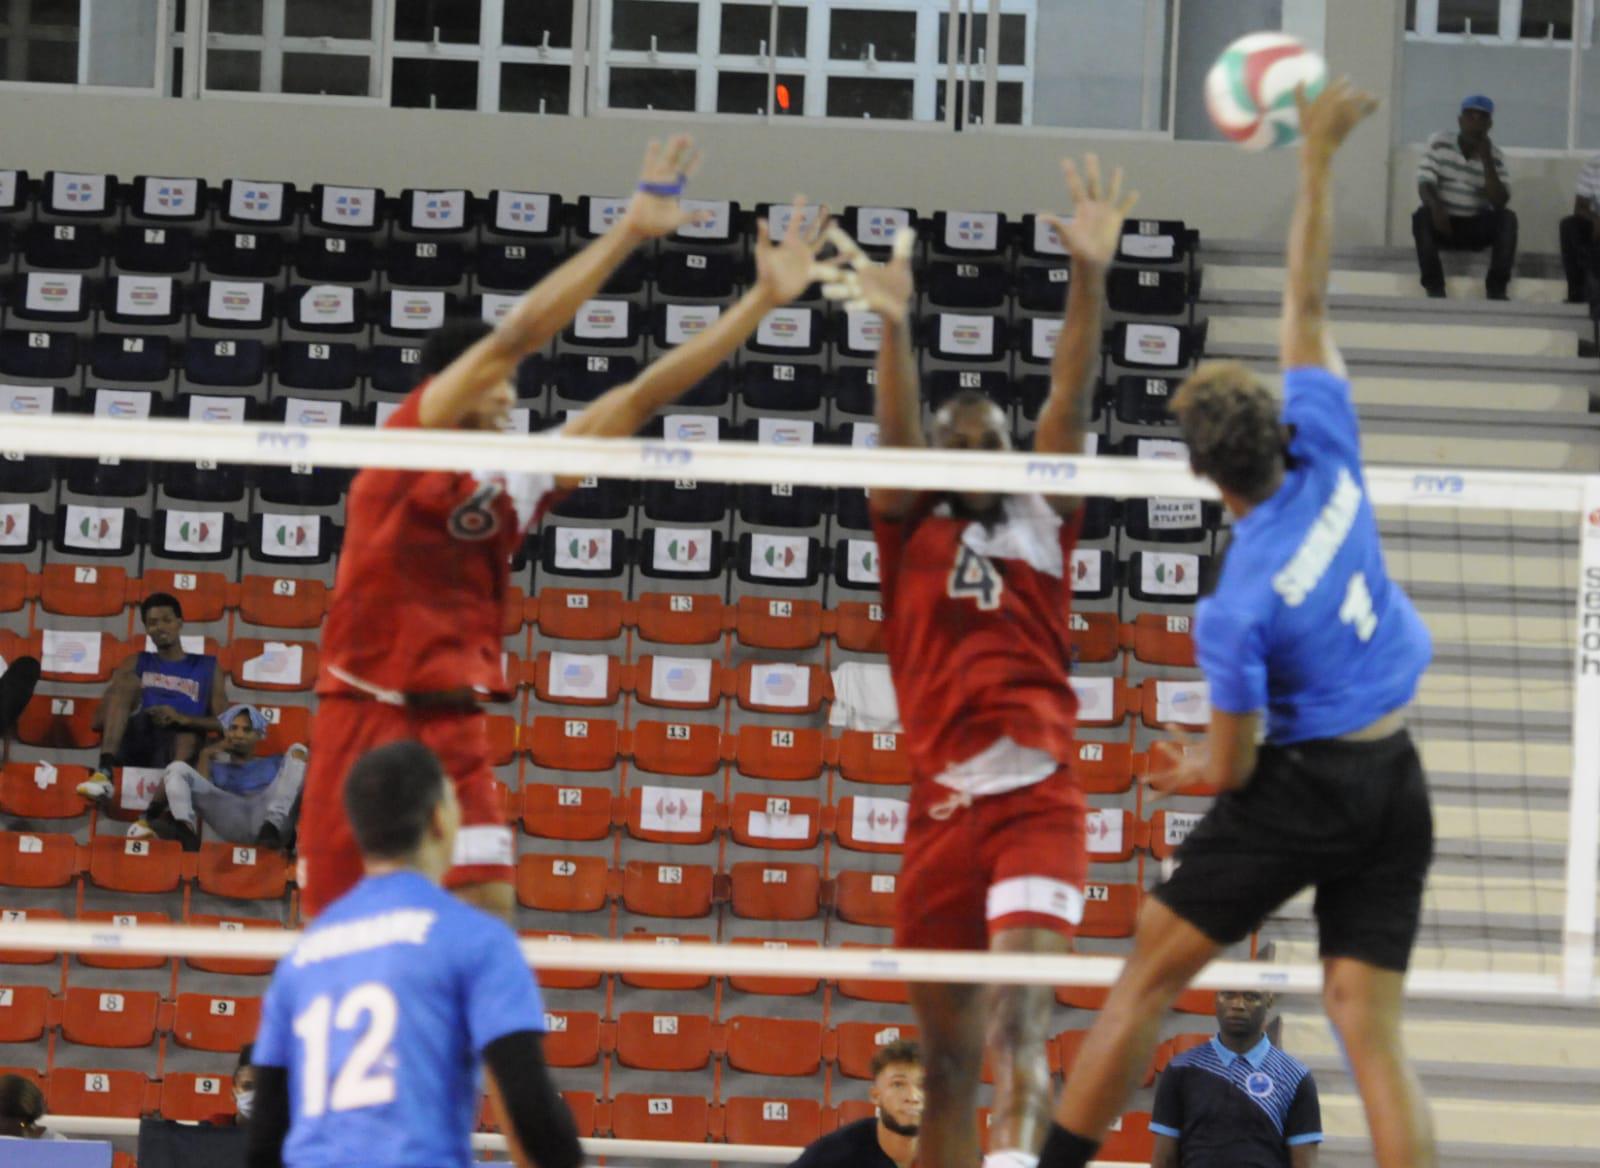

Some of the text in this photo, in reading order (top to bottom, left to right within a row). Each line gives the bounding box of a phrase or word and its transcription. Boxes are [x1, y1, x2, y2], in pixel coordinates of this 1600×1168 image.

[60, 226, 69, 238] 6
[152, 229, 160, 242] 7
[241, 235, 249, 247] 8
[331, 240, 340, 252] 9
[419, 244, 435, 256] 10
[35, 333, 44, 346] 6
[129, 338, 137, 352] 7
[220, 342, 228, 355] 8
[315, 345, 323, 358] 9
[403, 349, 419, 362] 10
[590, 357, 606, 370] 12
[776, 366, 792, 379] 14
[962, 373, 979, 386] 16
[447, 481, 502, 541] 6
[81, 569, 90, 582] 7
[181, 575, 190, 588] 8
[947, 544, 1003, 611] 4
[280, 580, 290, 593] 9
[571, 597, 584, 606] 12
[673, 597, 690, 610] 13
[773, 602, 790, 615] 14
[1171, 617, 1187, 631] 18
[60, 700, 68, 714] 7
[264, 708, 274, 721] 9
[568, 722, 586, 736] 12
[670, 727, 686, 737] 13
[774, 732, 790, 746] 14
[877, 735, 893, 748] 15
[1083, 745, 1101, 759] 17
[561, 790, 579, 804] 12
[771, 800, 788, 814] 14
[132, 841, 142, 853] 8
[240, 848, 250, 863] 9
[559, 861, 569, 875] 4
[663, 868, 680, 882] 13
[767, 870, 784, 882] 14
[1089, 887, 1105, 899] 17
[106, 995, 117, 1009] 8
[217, 1001, 228, 1014] 9
[546, 1016, 565, 1030] 12
[657, 1018, 676, 1033] 13
[292, 979, 399, 1118] 12
[93, 1075, 103, 1090] 8
[202, 1080, 212, 1092] 9
[654, 1102, 669, 1112] 13
[766, 1104, 786, 1118] 14
